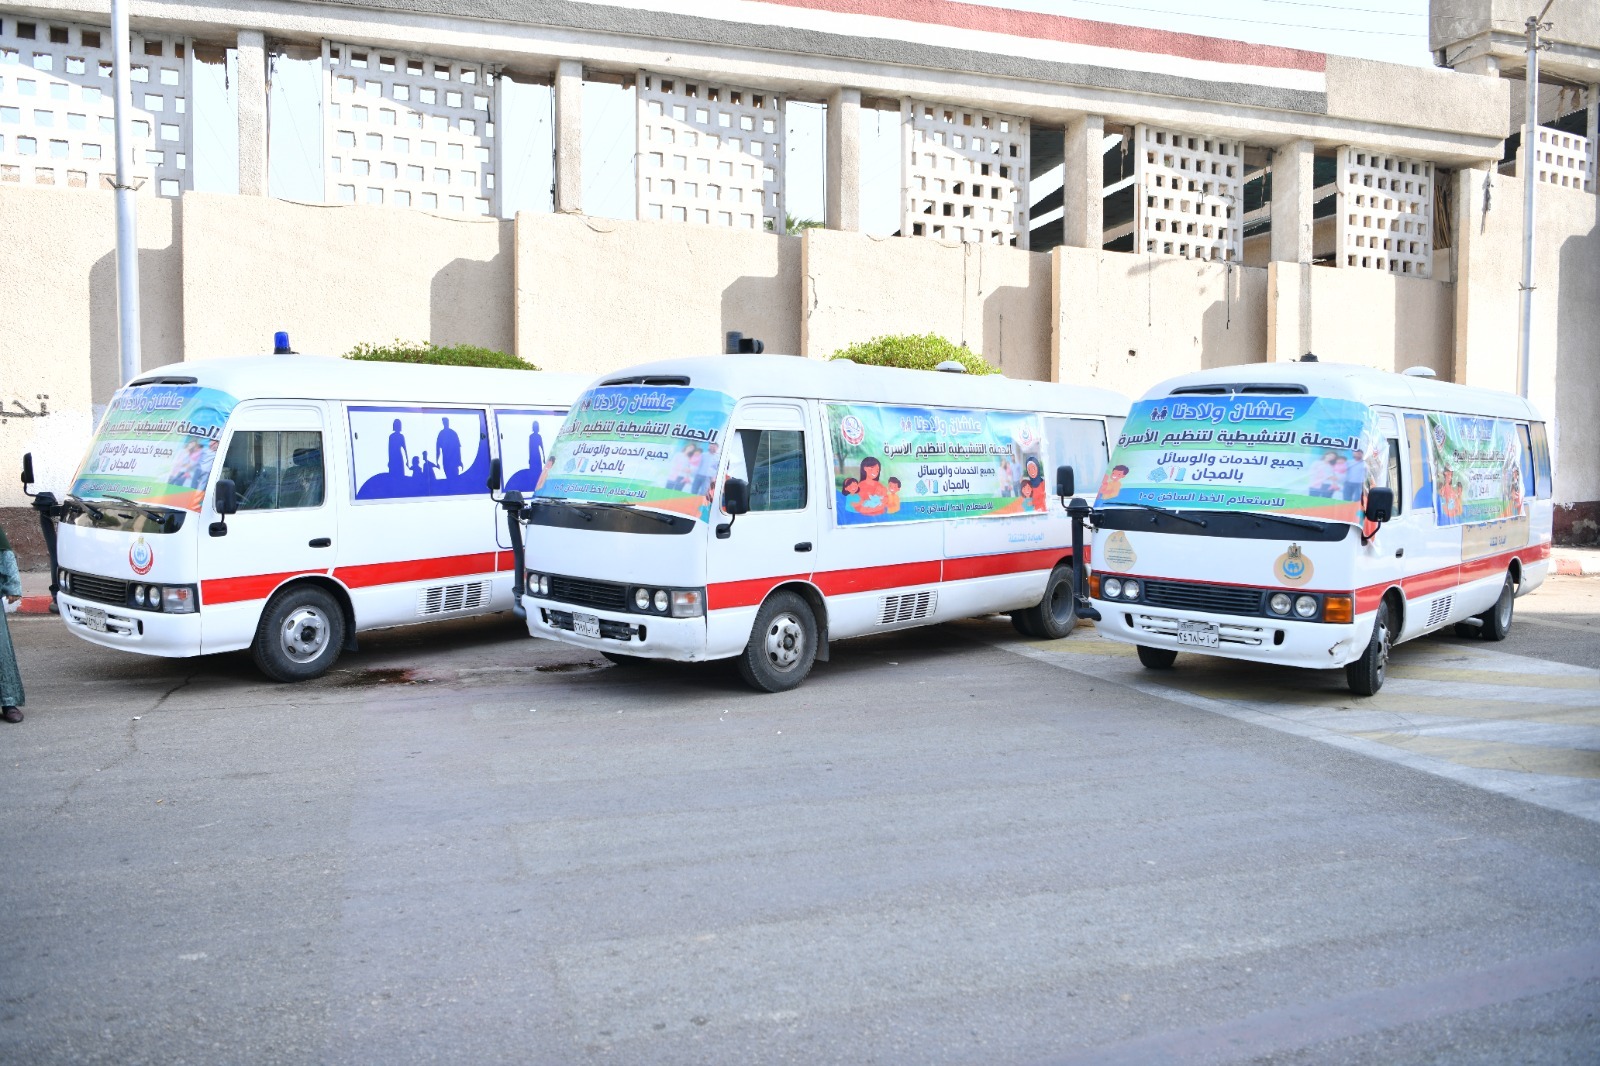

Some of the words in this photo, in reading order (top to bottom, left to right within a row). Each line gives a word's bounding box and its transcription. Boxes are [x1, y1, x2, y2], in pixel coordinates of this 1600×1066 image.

[147, 391, 184, 412] علشان
[593, 394, 628, 414] ولادنا
[628, 392, 675, 414] علشان
[1171, 403, 1226, 425] ولادنا
[1228, 400, 1295, 423] علشان
[177, 420, 221, 440] الحملة
[580, 420, 616, 436] لتنظيم
[615, 419, 670, 437] التنشيطية
[914, 415, 947, 436] ولادنا
[950, 415, 981, 437] علشان
[671, 423, 719, 443] الحملة
[1118, 428, 1159, 448] الأسرة
[1160, 430, 1214, 446] لتنظيم
[1217, 429, 1296, 446] التنشيطية
[1300, 431, 1360, 450] الحملة
[153, 447, 173, 458] جميع
[573, 443, 610, 457] والوسائل
[612, 447, 645, 456] الخدمات
[644, 449, 669, 461] جميع
[915, 442, 946, 460] لتنظيم
[948, 442, 987, 458] التنشيطية
[109, 458, 137, 472] بالمجان
[1157, 452, 1217, 466] والوسائل
[1219, 455, 1268, 466] الخدمات
[1270, 459, 1304, 469] جميع
[590, 459, 626, 474] بالمجان
[917, 464, 953, 478] والوسائل
[954, 466, 979, 475] الخدمات
[980, 467, 995, 477] جميع
[1191, 468, 1244, 483] بالمجان
[564, 483, 589, 493] الساخن
[589, 485, 607, 494] الخط
[607, 487, 648, 499] للاستعلام
[943, 479, 970, 493] بالمجان
[1157, 493, 1195, 502] الساخن
[1198, 493, 1225, 502] الخط
[1226, 494, 1285, 507] للاستعلام
[926, 504, 950, 514] الساخن
[965, 502, 994, 512] للاستعلام
